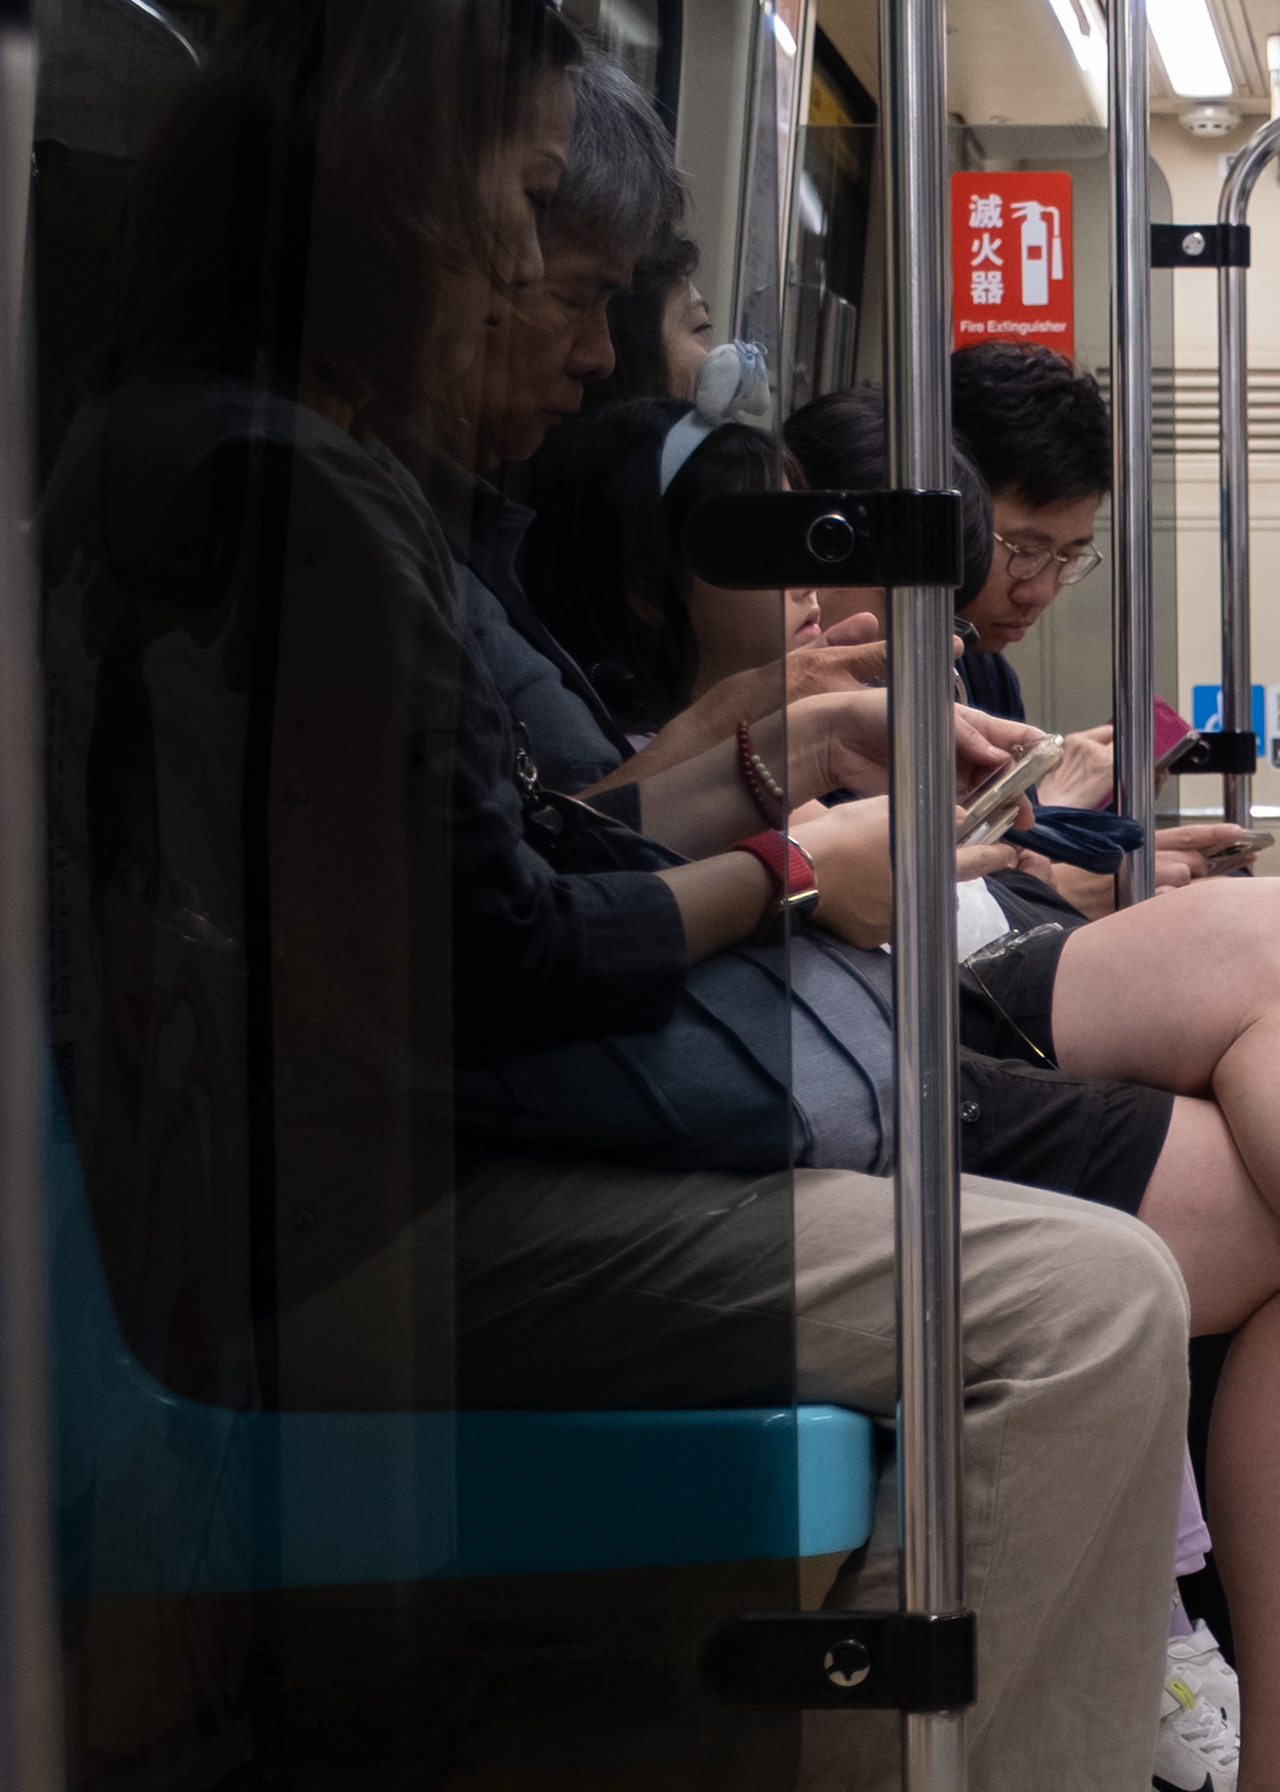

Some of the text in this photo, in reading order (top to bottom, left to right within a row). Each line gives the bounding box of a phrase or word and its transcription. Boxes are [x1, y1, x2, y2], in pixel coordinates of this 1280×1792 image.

[968, 193, 1004, 304] 滅火器
[960, 319, 1067, 335] Fire Extinguisher
